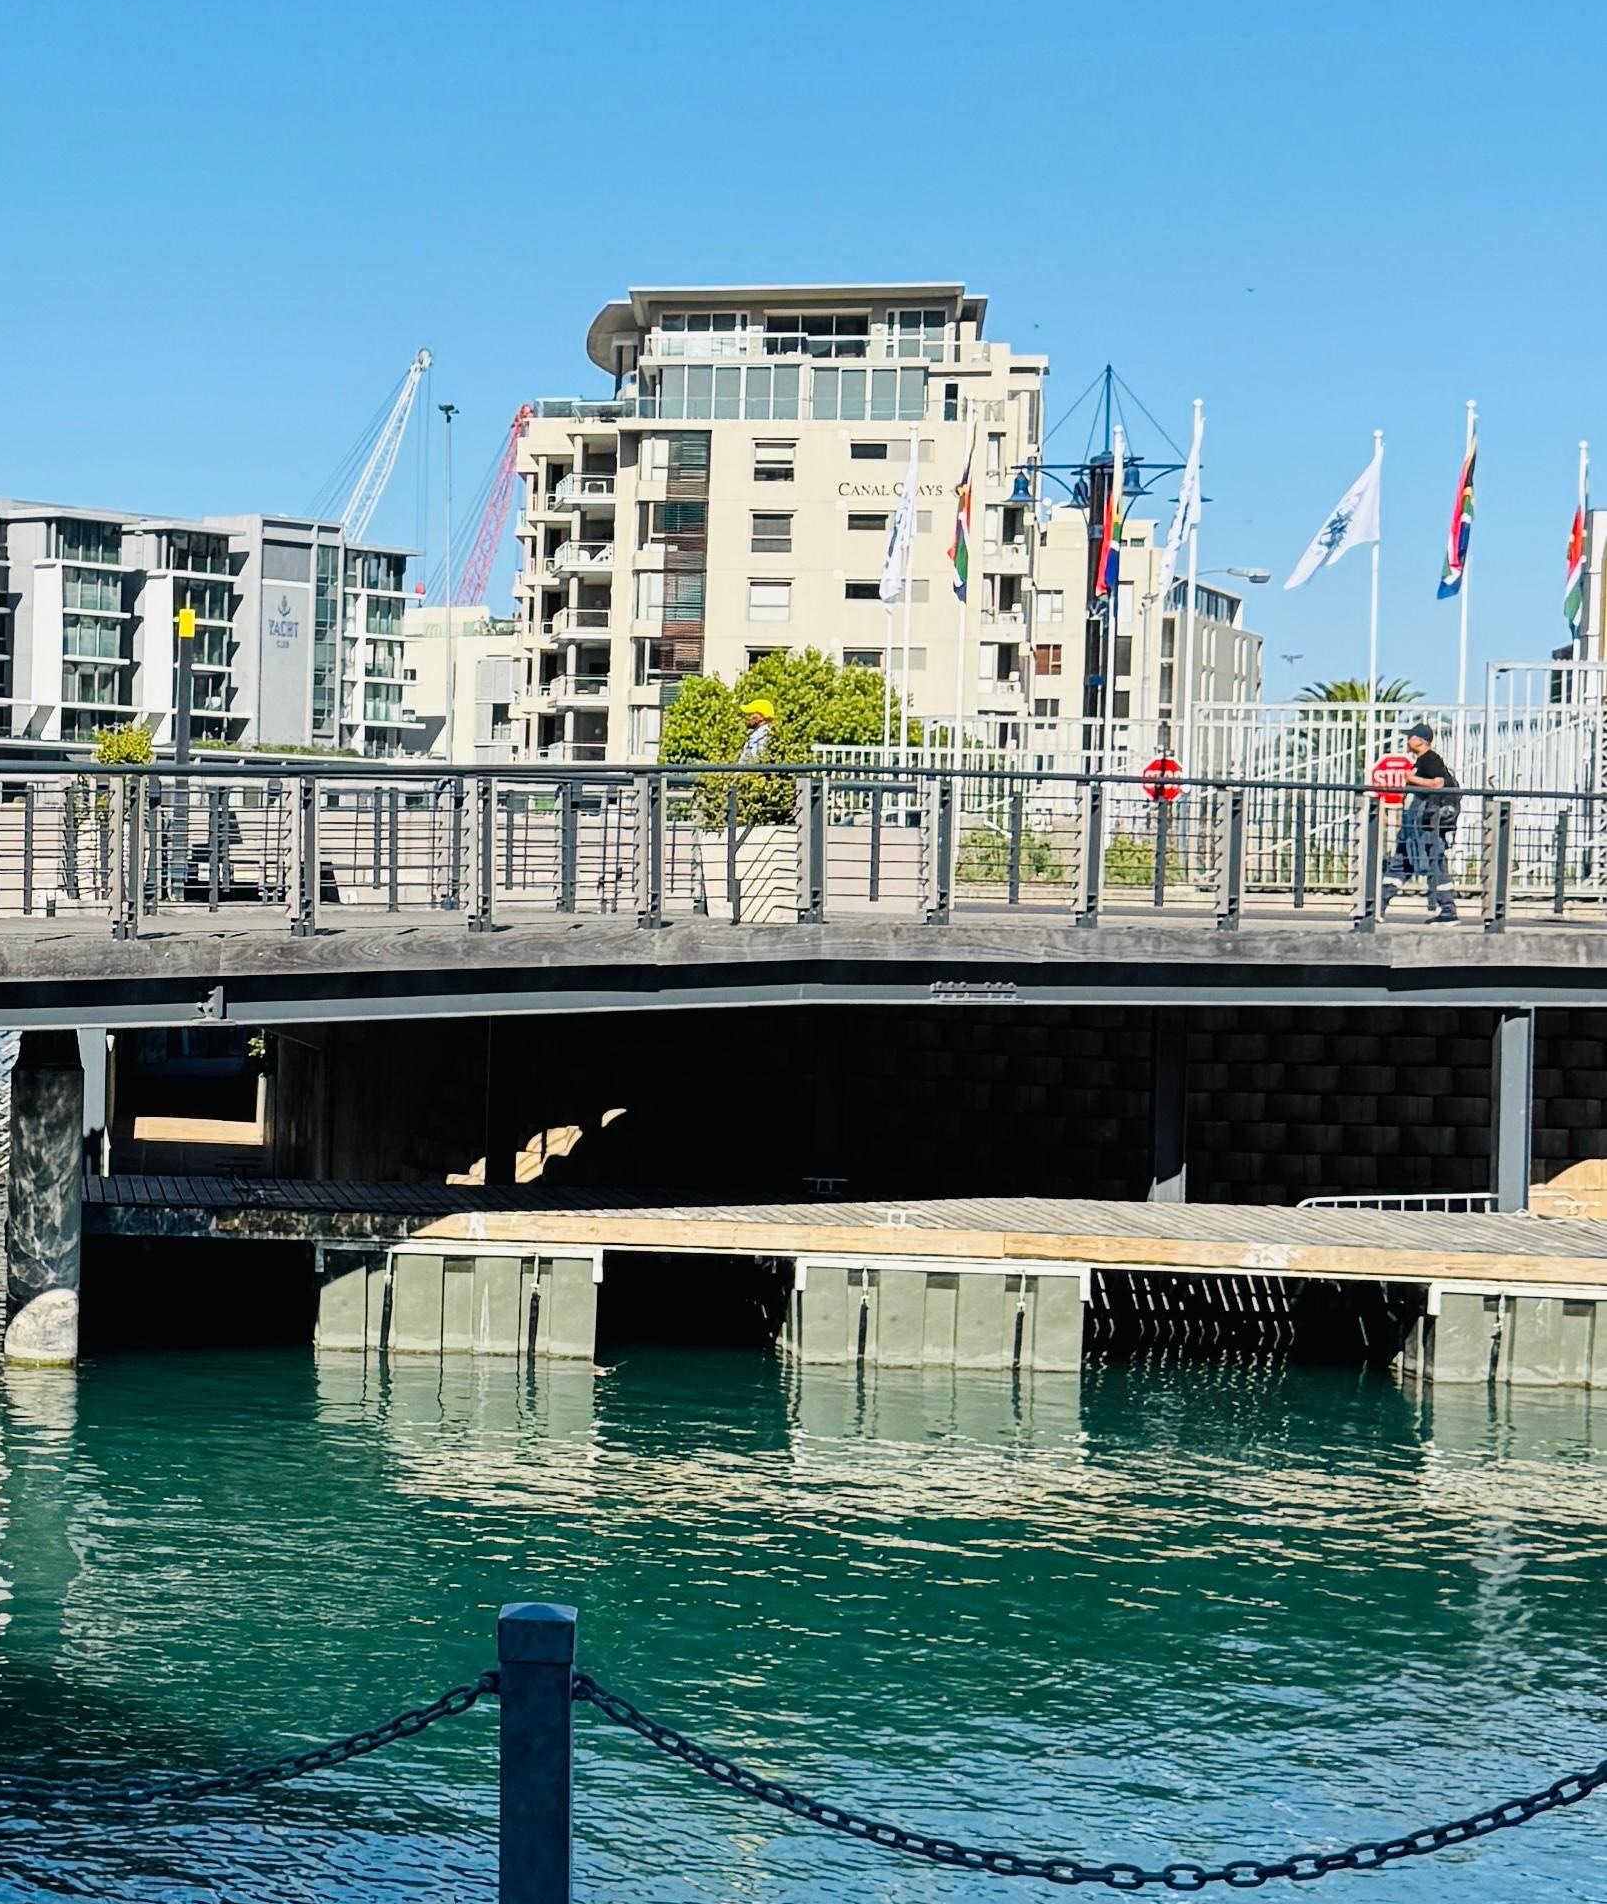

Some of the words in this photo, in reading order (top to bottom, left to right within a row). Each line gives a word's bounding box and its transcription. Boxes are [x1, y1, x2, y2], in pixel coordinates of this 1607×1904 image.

[838, 482, 890, 496] CANAL
[893, 481, 943, 497] QAYS
[268, 619, 299, 638] YACHT
[1373, 769, 1407, 789] STO
